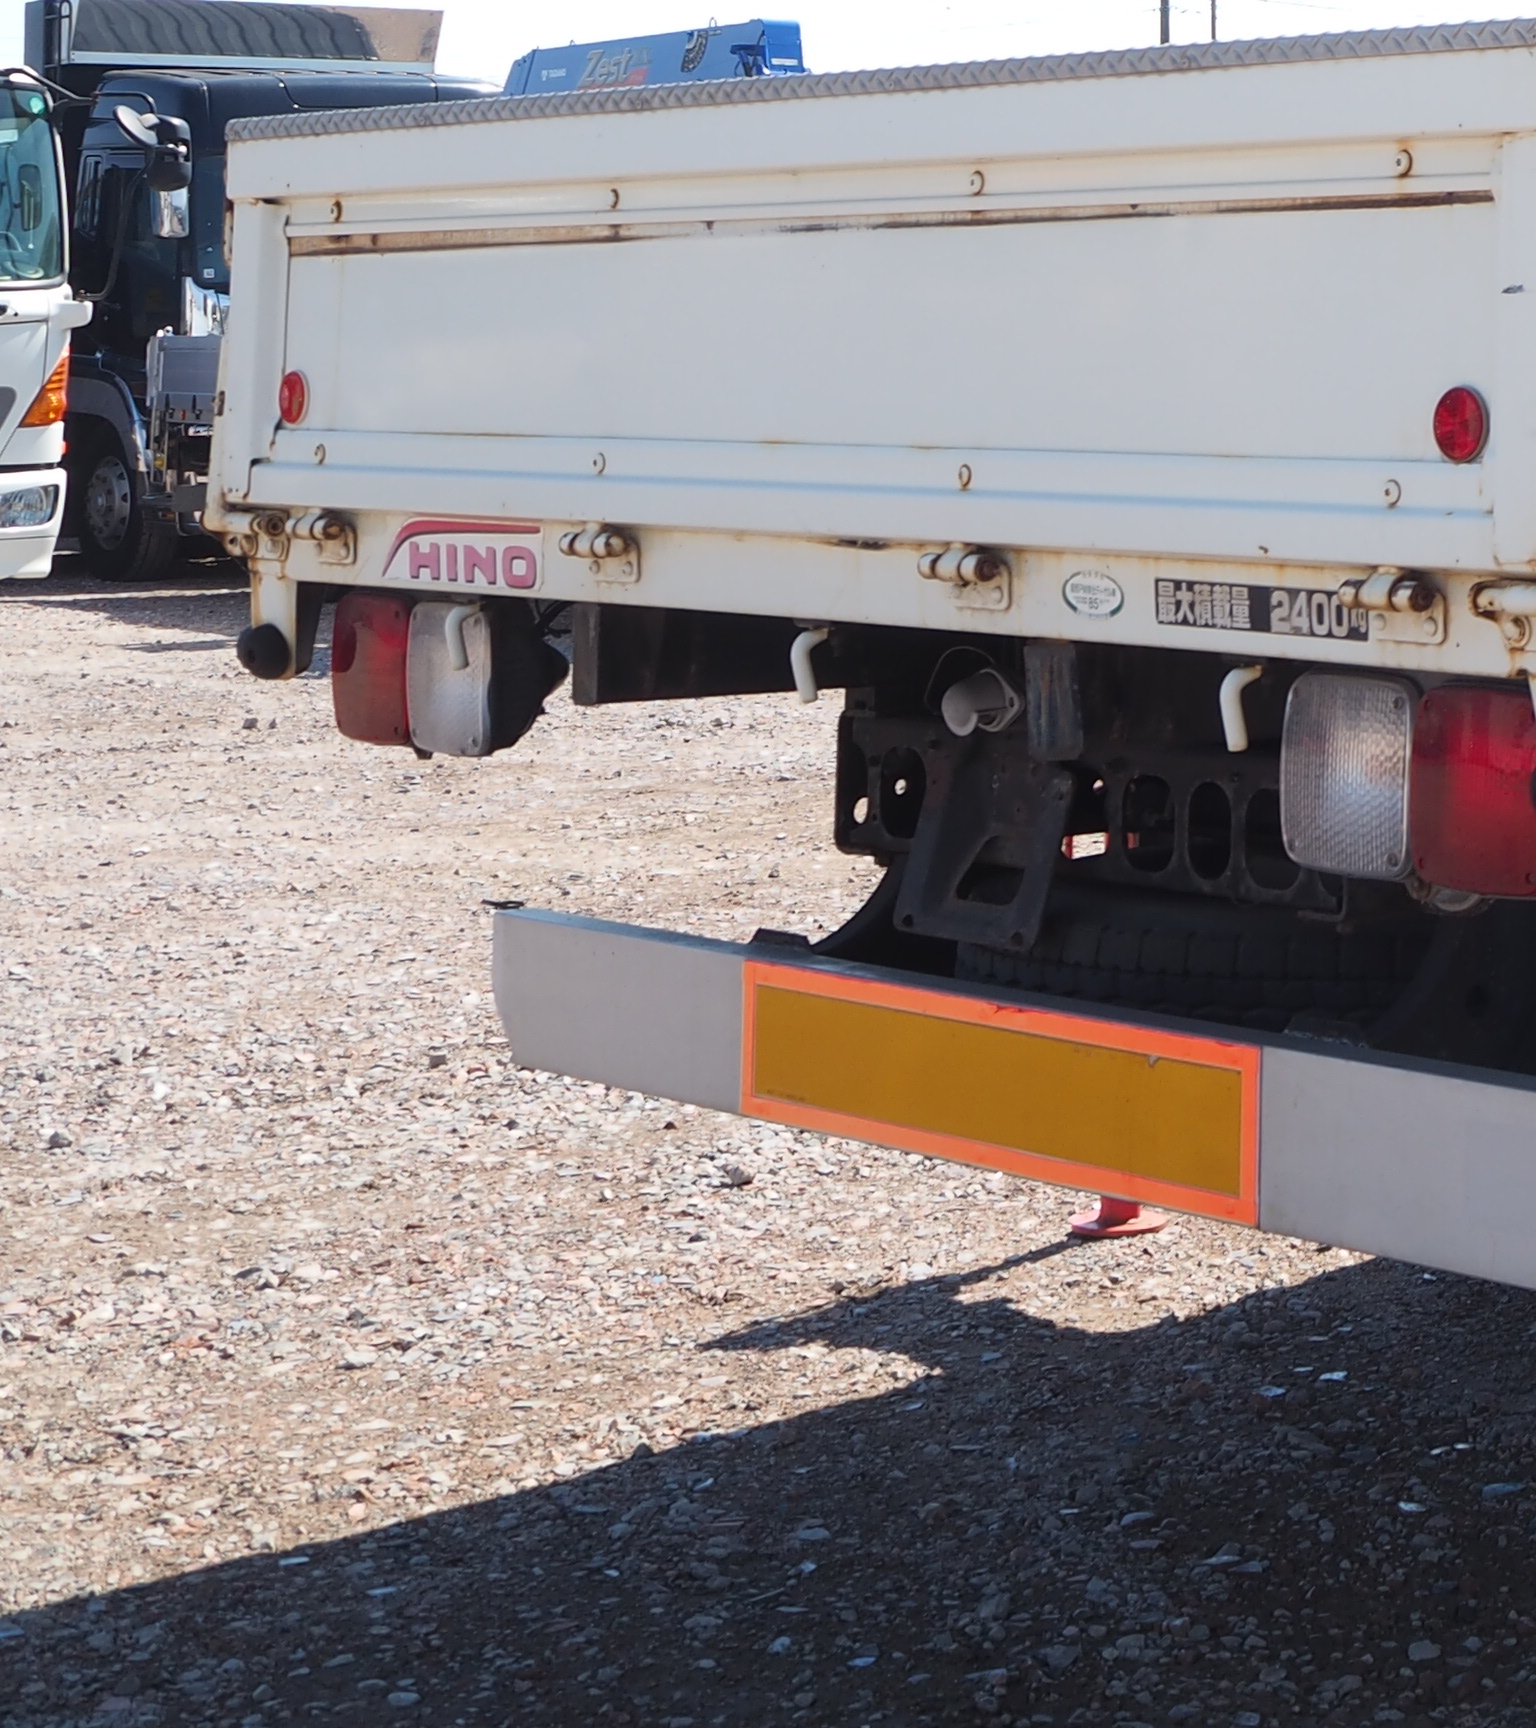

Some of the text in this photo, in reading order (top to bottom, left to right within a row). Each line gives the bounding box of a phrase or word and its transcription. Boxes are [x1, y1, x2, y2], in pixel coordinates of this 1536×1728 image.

[580, 47, 633, 87] Zest
[409, 541, 538, 590] HINO
[1157, 580, 1251, 630] 最大積載量
